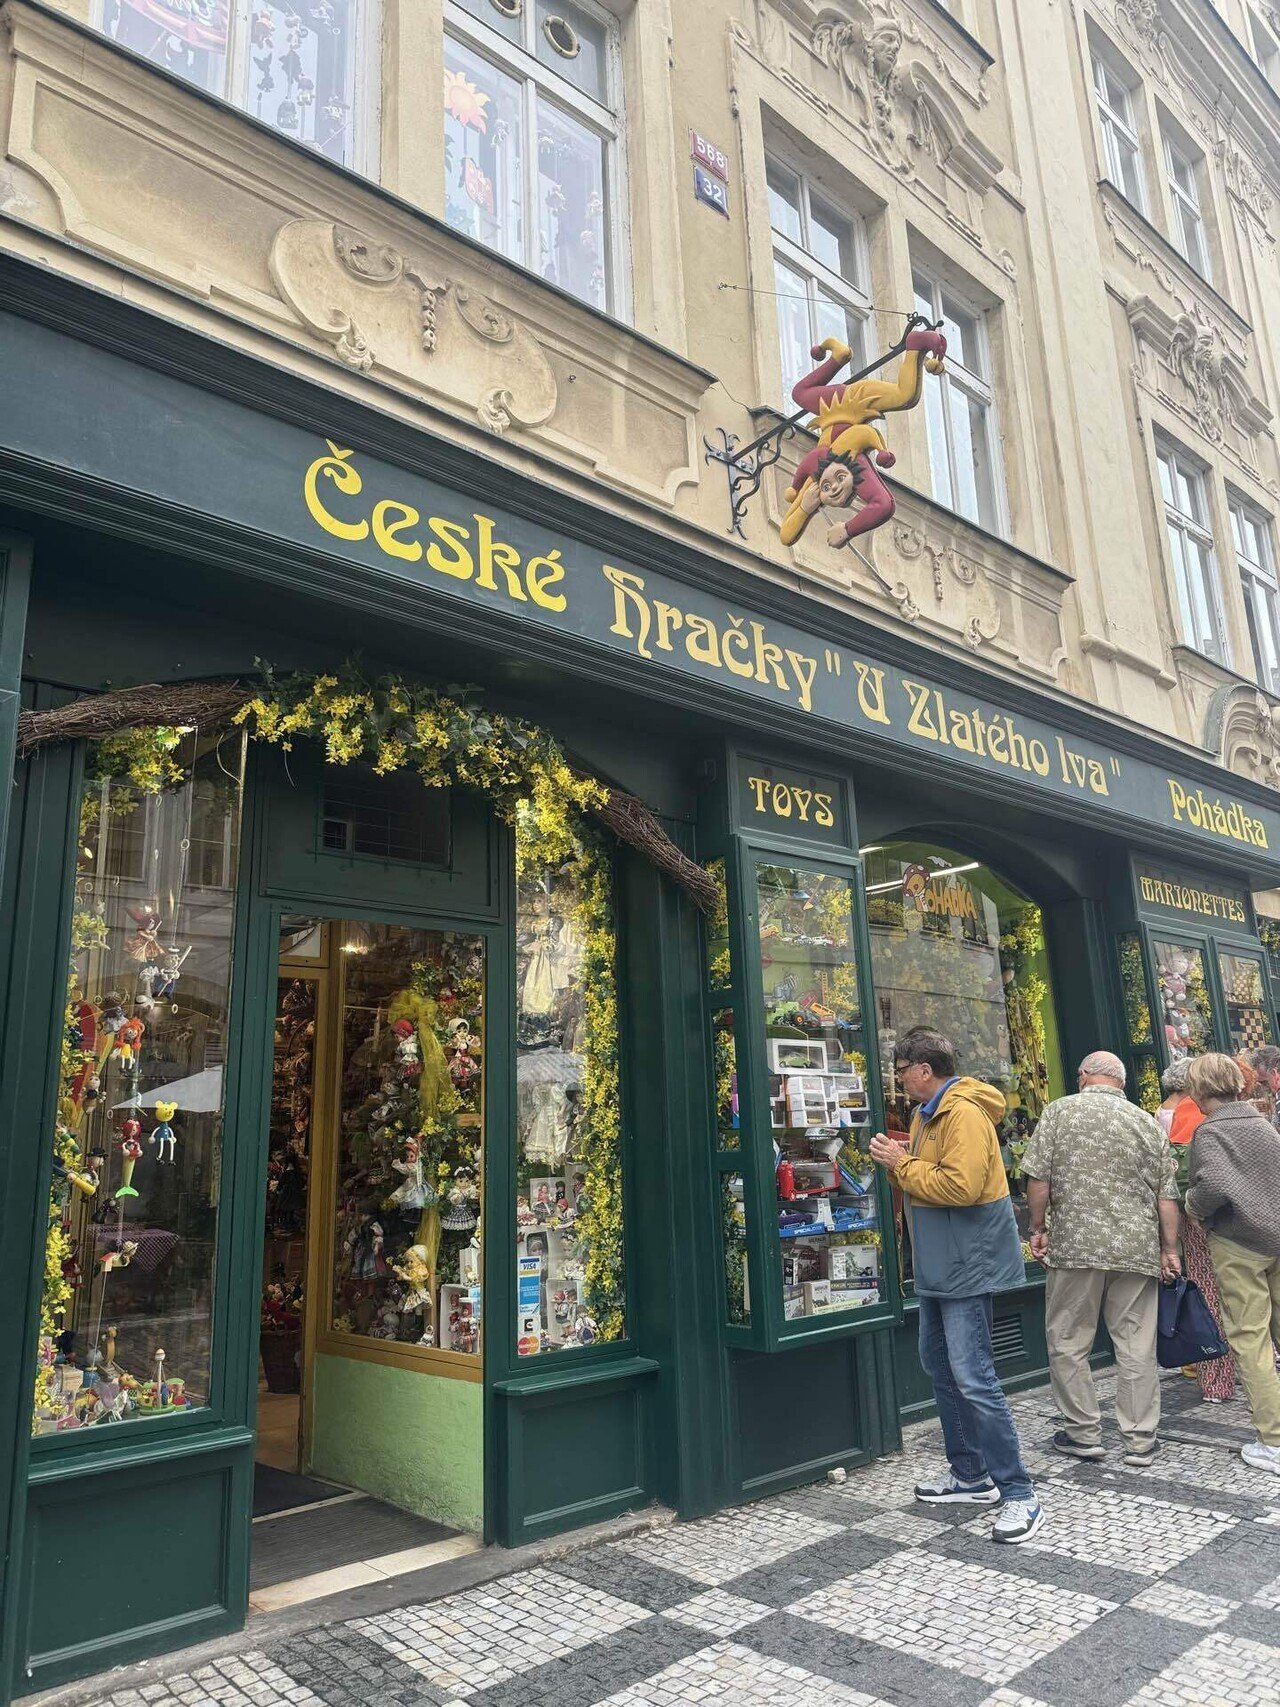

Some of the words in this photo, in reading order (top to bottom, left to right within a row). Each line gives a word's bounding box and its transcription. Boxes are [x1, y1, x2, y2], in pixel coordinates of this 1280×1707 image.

[696, 134, 725, 169] 568
[703, 177, 723, 204] 32
[303, 438, 568, 613] České
[901, 679, 1050, 777] Zlatého
[748, 776, 834, 827] TOYS
[1167, 779, 1269, 849] Pohádka
[1140, 876, 1246, 923] MARIONETTES
[522, 1262, 537, 1270] VISA
